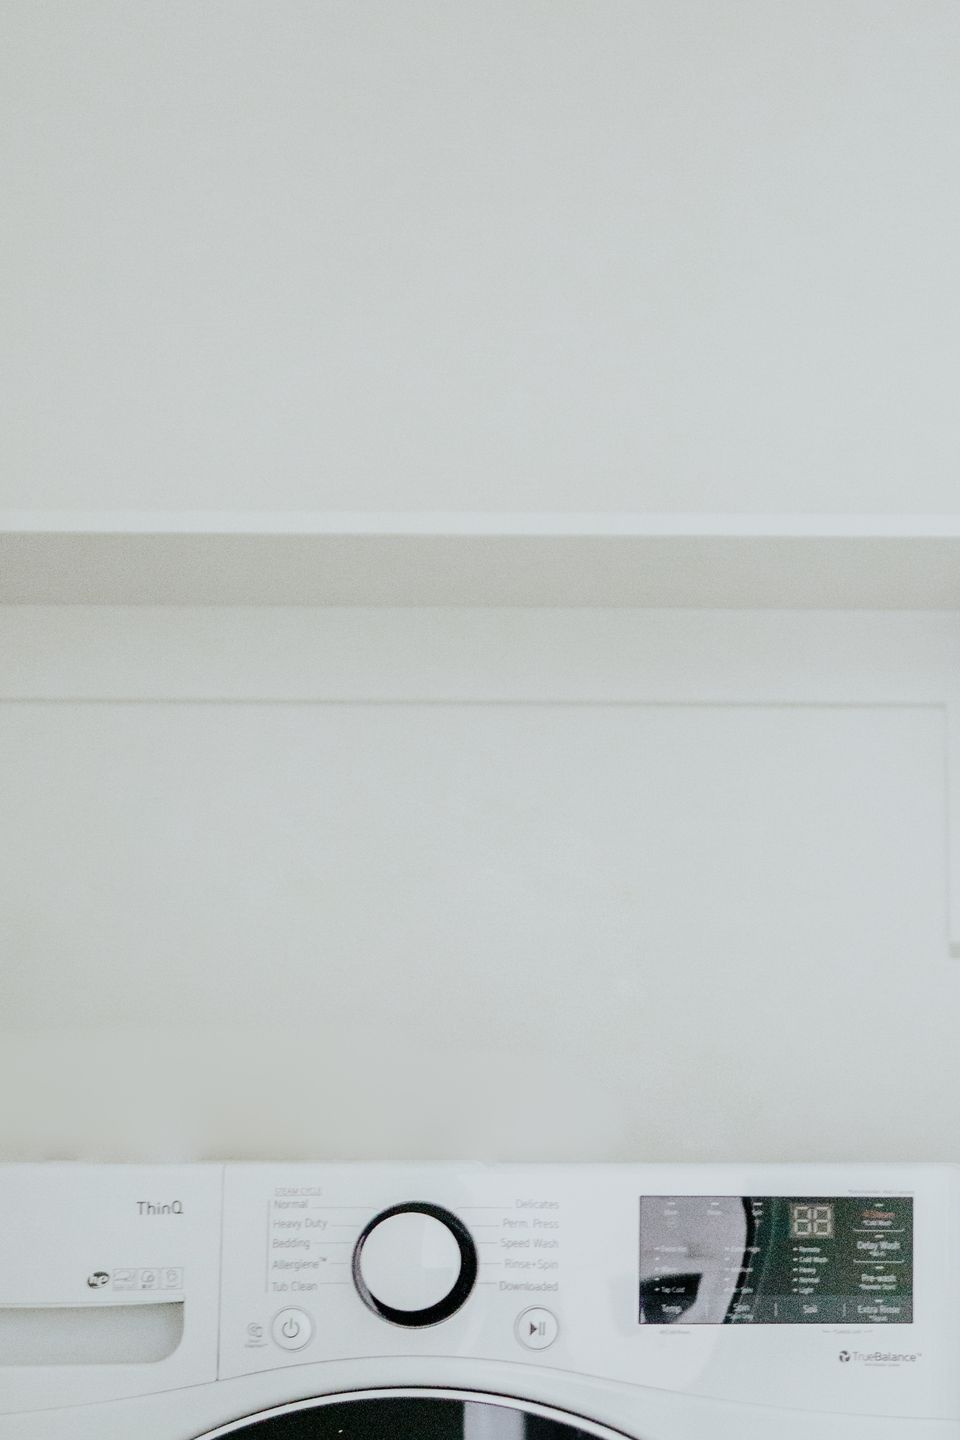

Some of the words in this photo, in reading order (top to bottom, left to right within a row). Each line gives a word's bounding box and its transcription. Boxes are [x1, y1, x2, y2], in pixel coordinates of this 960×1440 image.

[136, 1200, 184, 1215] ThinQ
[274, 1199, 308, 1209] Normal
[515, 1199, 560, 1209] Delicates
[273, 1220, 301, 1231] Heavy
[305, 1218, 328, 1230] Duty
[533, 1218, 560, 1229] Press
[272, 1239, 310, 1250] Bedding
[500, 1238, 530, 1249] Speed
[533, 1239, 560, 1248] Wash
[857, 1241, 878, 1251] Delay
[504, 1259, 559, 1271] Rinse+Spin
[272, 1281, 288, 1291] Tub
[291, 1281, 318, 1291] Clean
[499, 1280, 559, 1291] Downloaded
